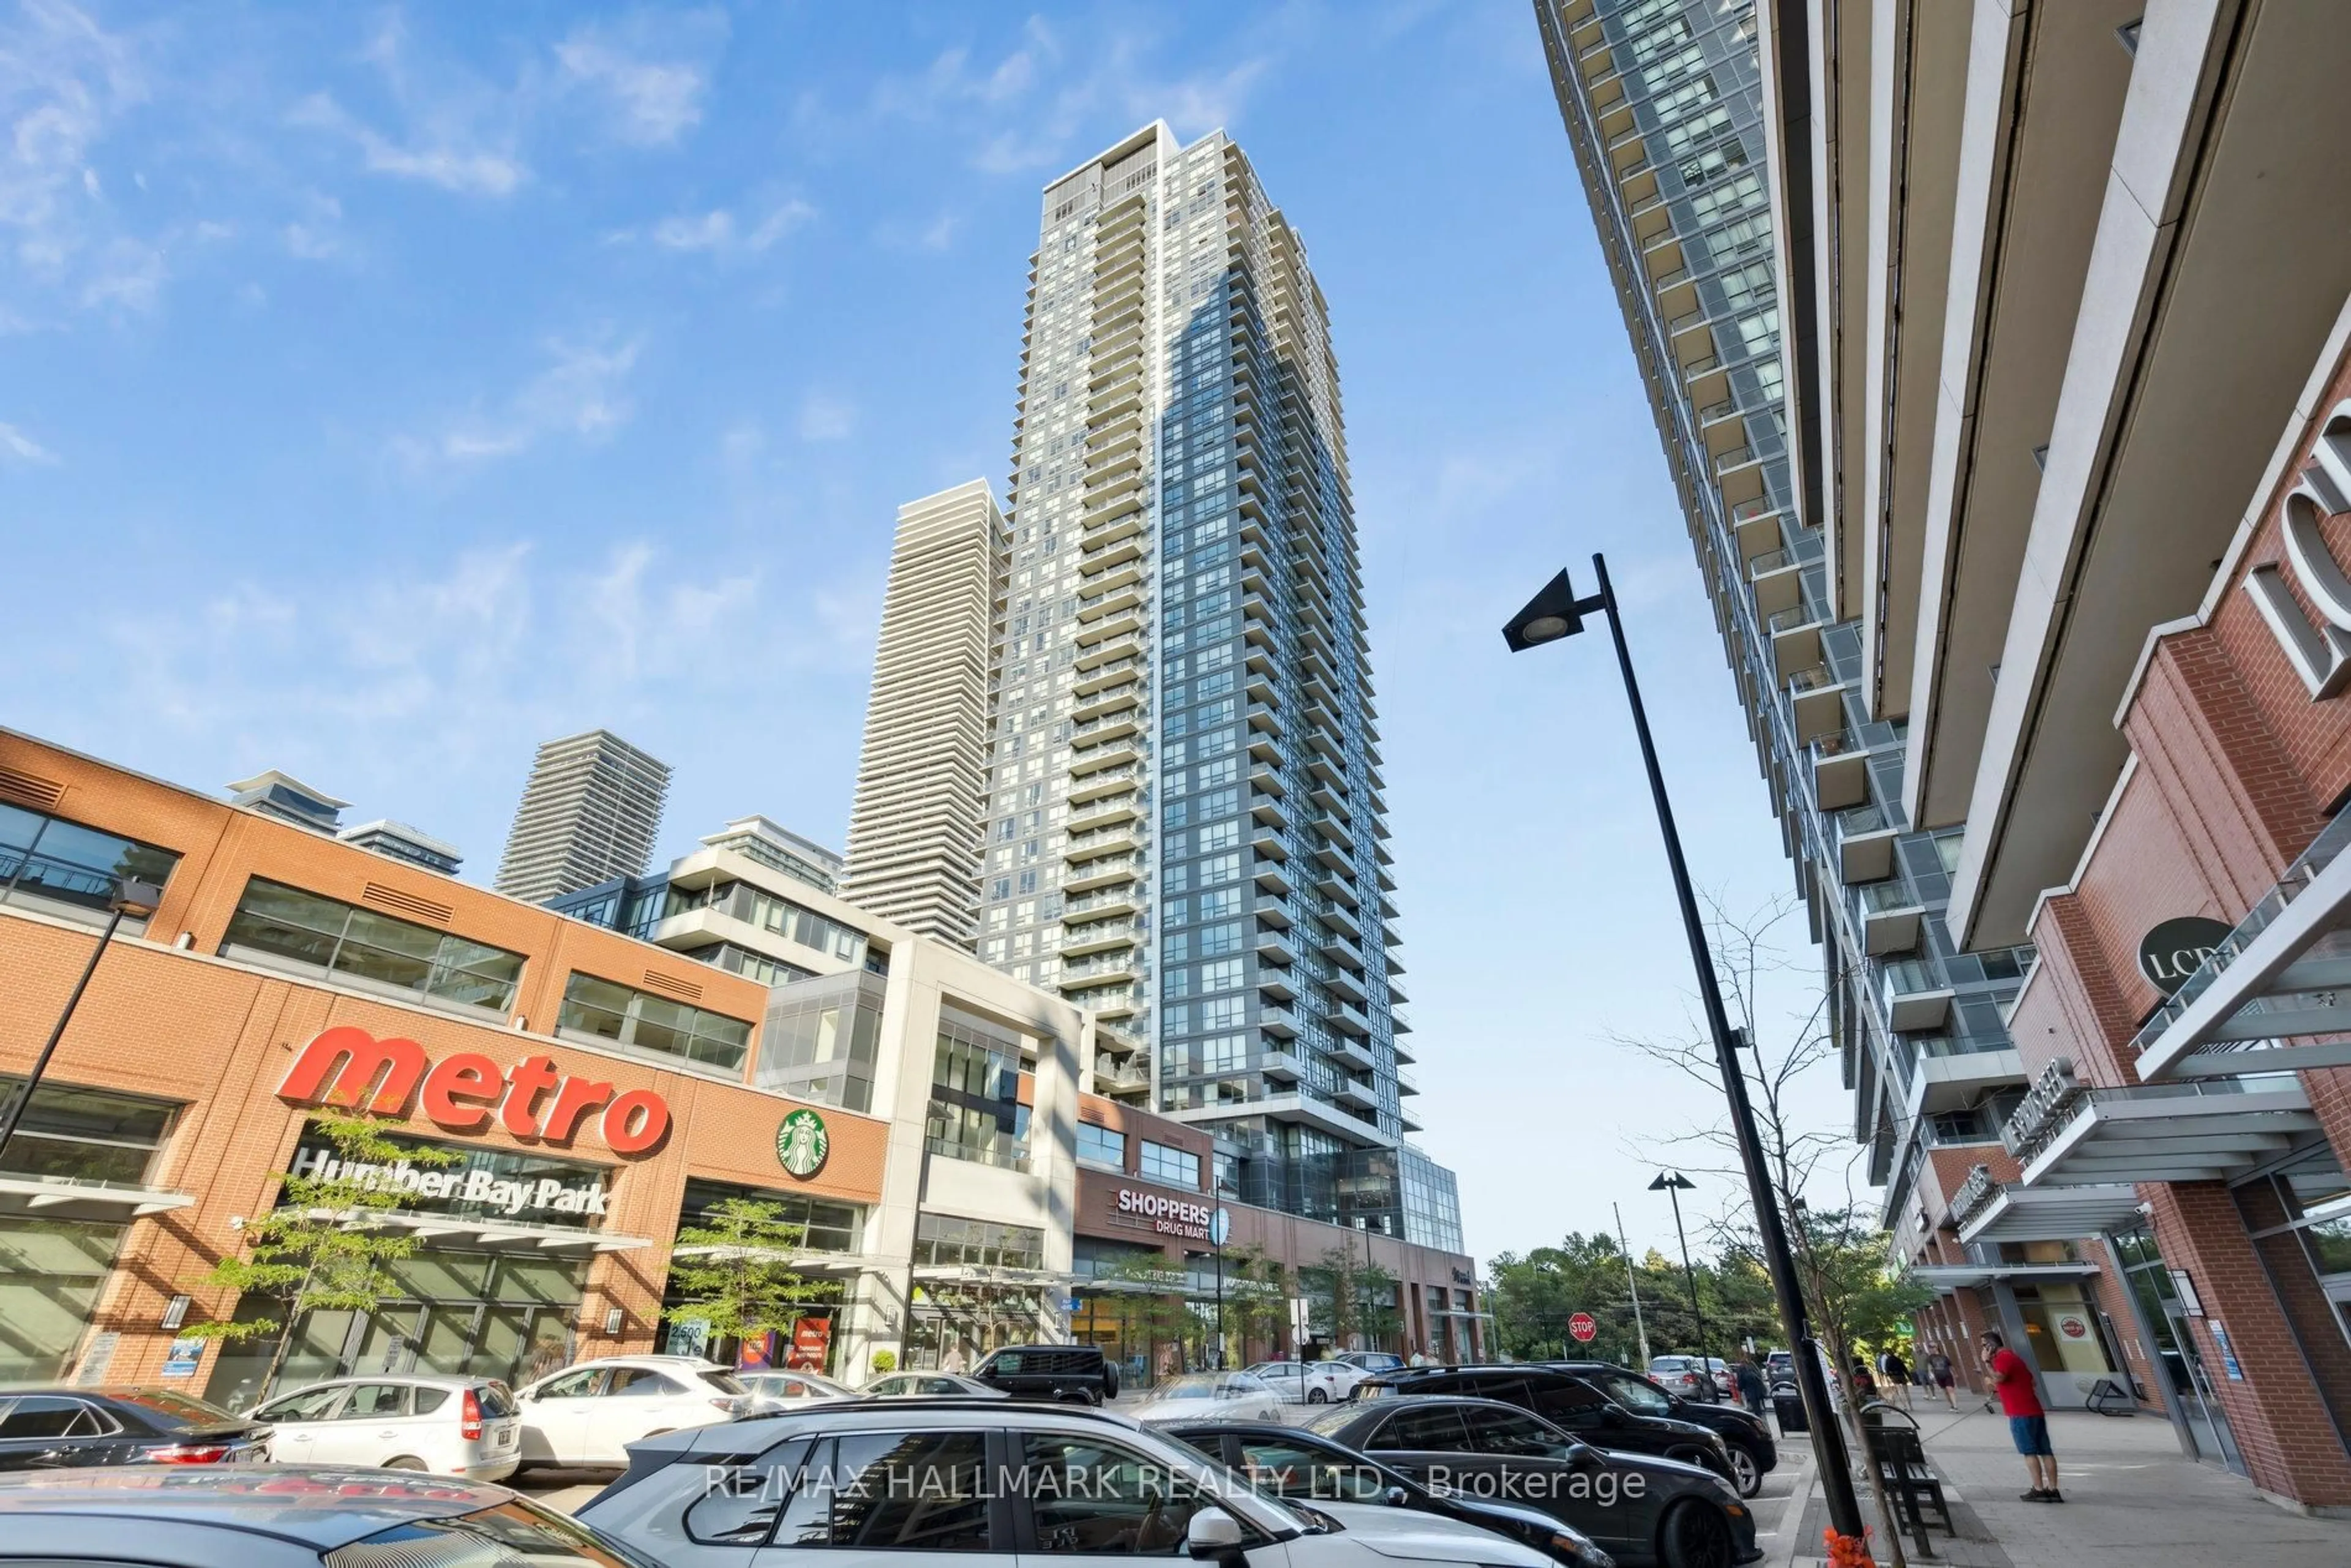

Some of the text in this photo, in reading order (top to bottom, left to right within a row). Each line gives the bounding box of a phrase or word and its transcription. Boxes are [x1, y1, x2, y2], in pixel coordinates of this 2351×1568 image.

[274, 1026, 669, 1153] metro
[291, 1147, 609, 1215] Humber Bay Park
[1118, 1189, 1210, 1226] SHOPPERS
[1157, 1219, 1210, 1240] DRUG MART
[1571, 1321, 1593, 1332] STOP
